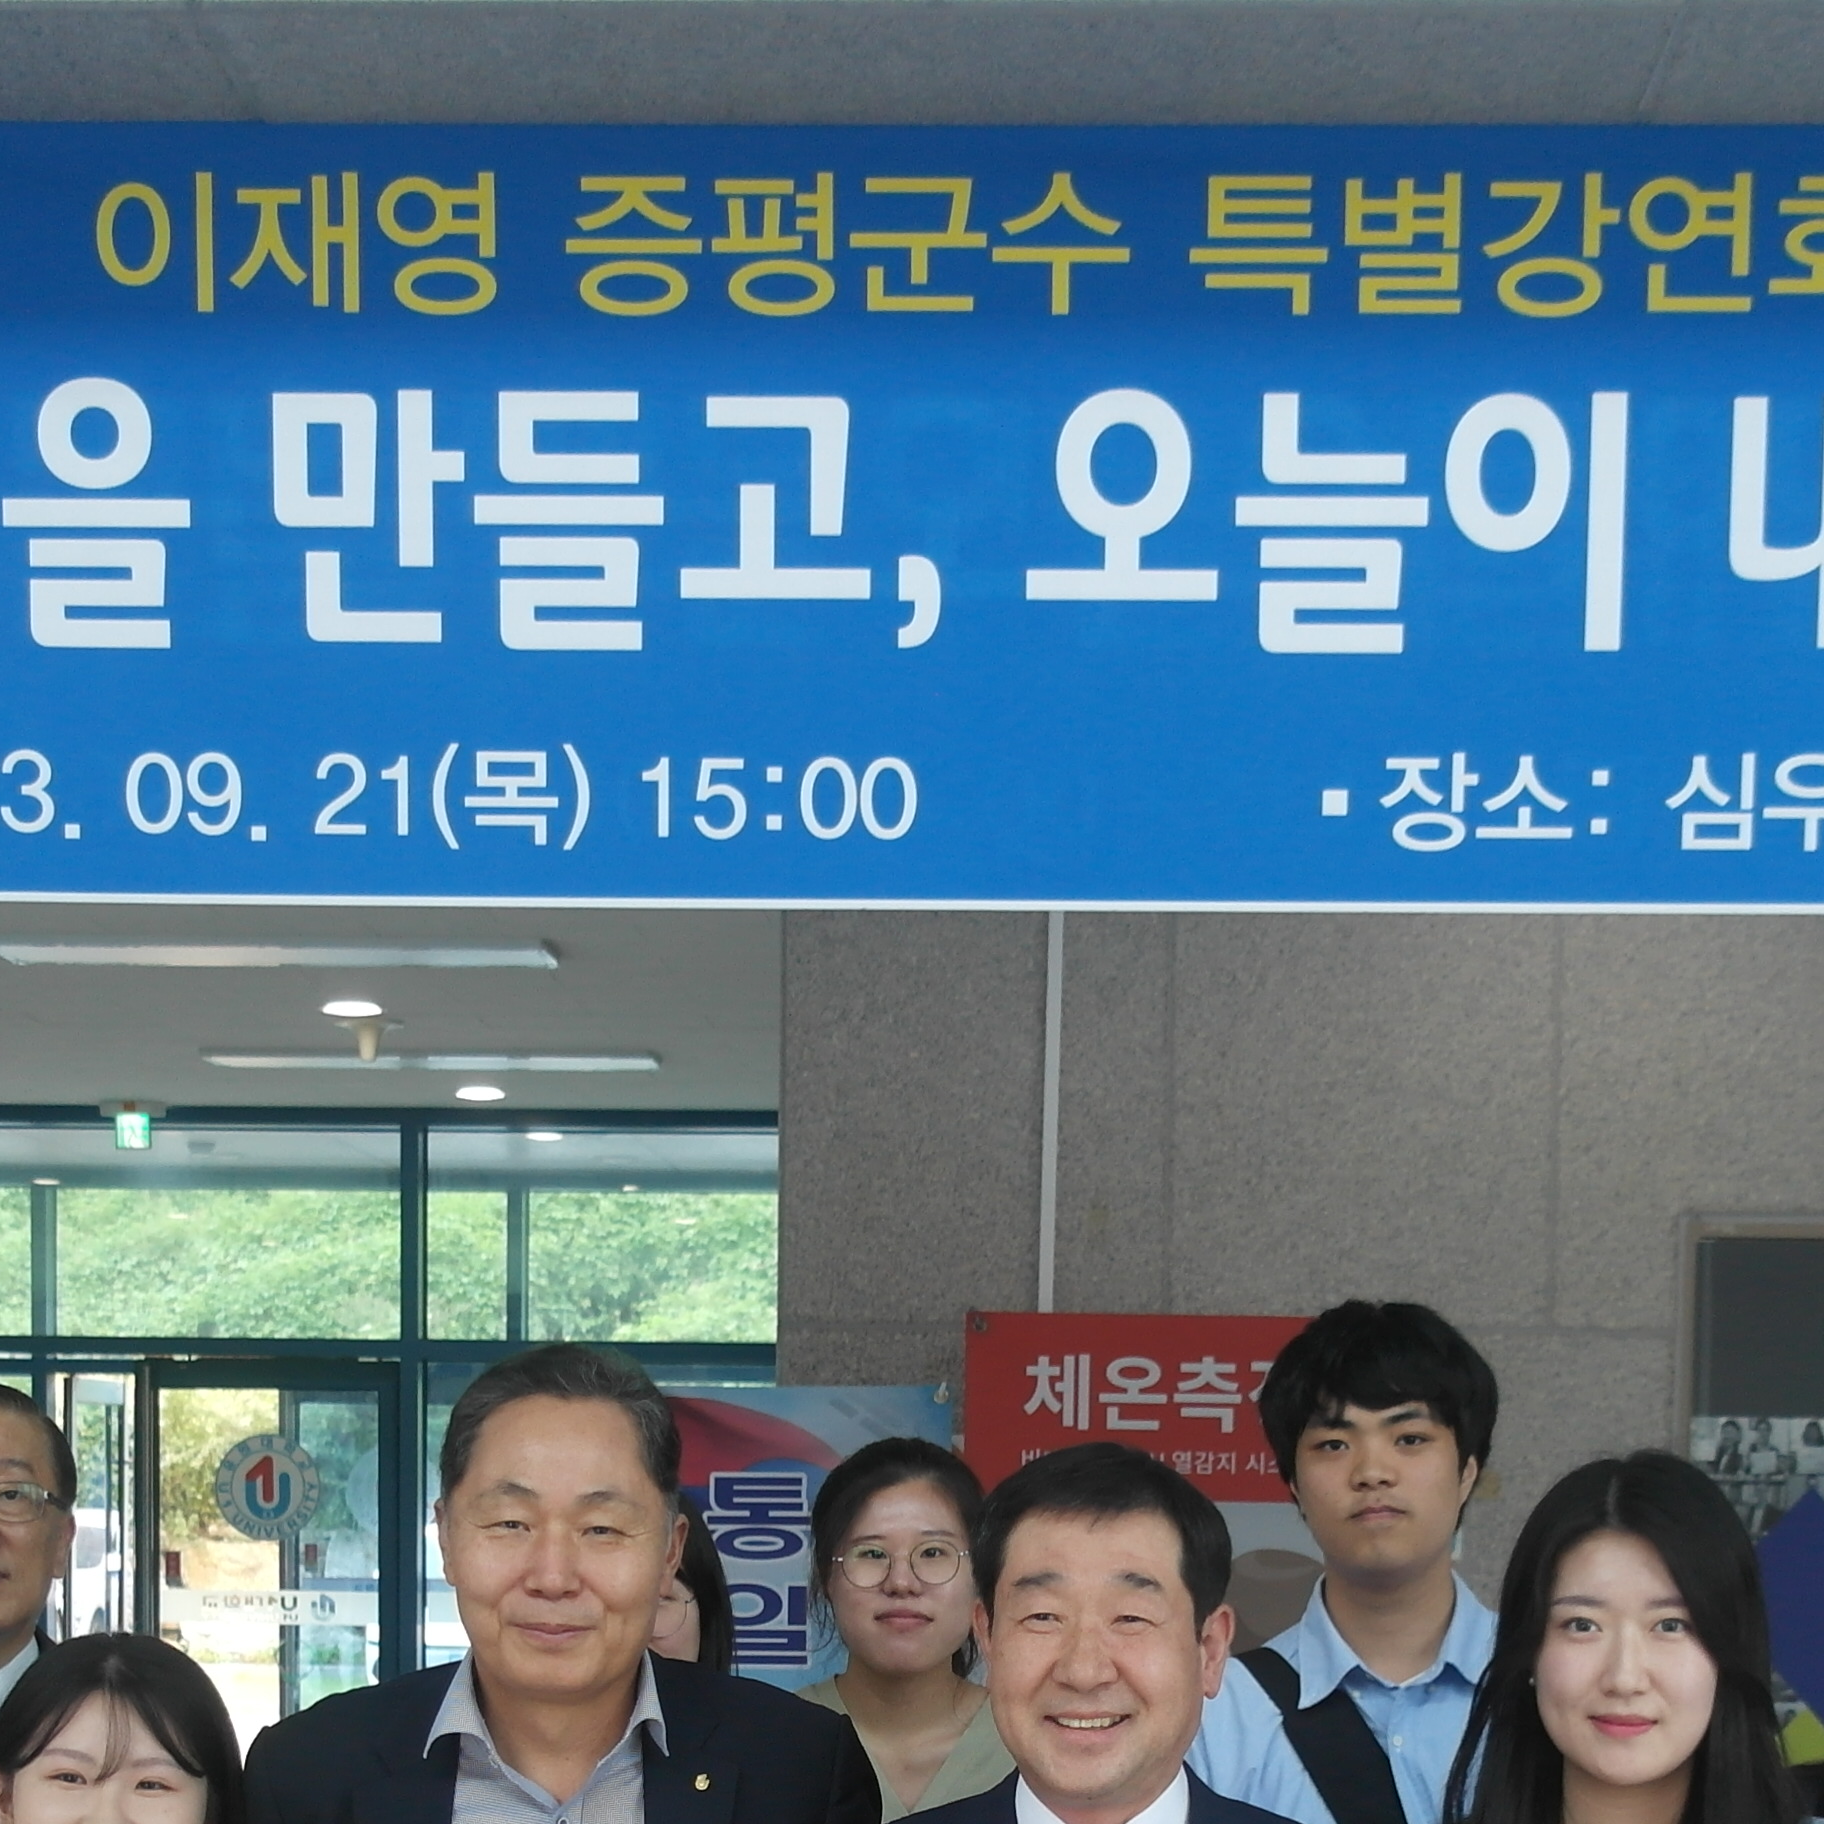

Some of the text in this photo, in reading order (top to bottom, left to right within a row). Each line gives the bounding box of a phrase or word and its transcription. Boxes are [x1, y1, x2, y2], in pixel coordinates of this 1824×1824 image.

[97, 172, 497, 315] 이재영
[566, 173, 1130, 316] 증평군수
[273, 390, 941, 651] 만들고,
[1026, 389, 1628, 654] 오늘이
[126, 752, 267, 842] 09.
[315, 743, 590, 850] 21(목)
[642, 757, 918, 840] 15:00
[1380, 752, 1609, 852] 장소:
[232, 1482, 318, 1539] UNIVERSITY
[1172, 1450, 1237, 1475] 열감지
[706, 1473, 812, 1667] 통일
